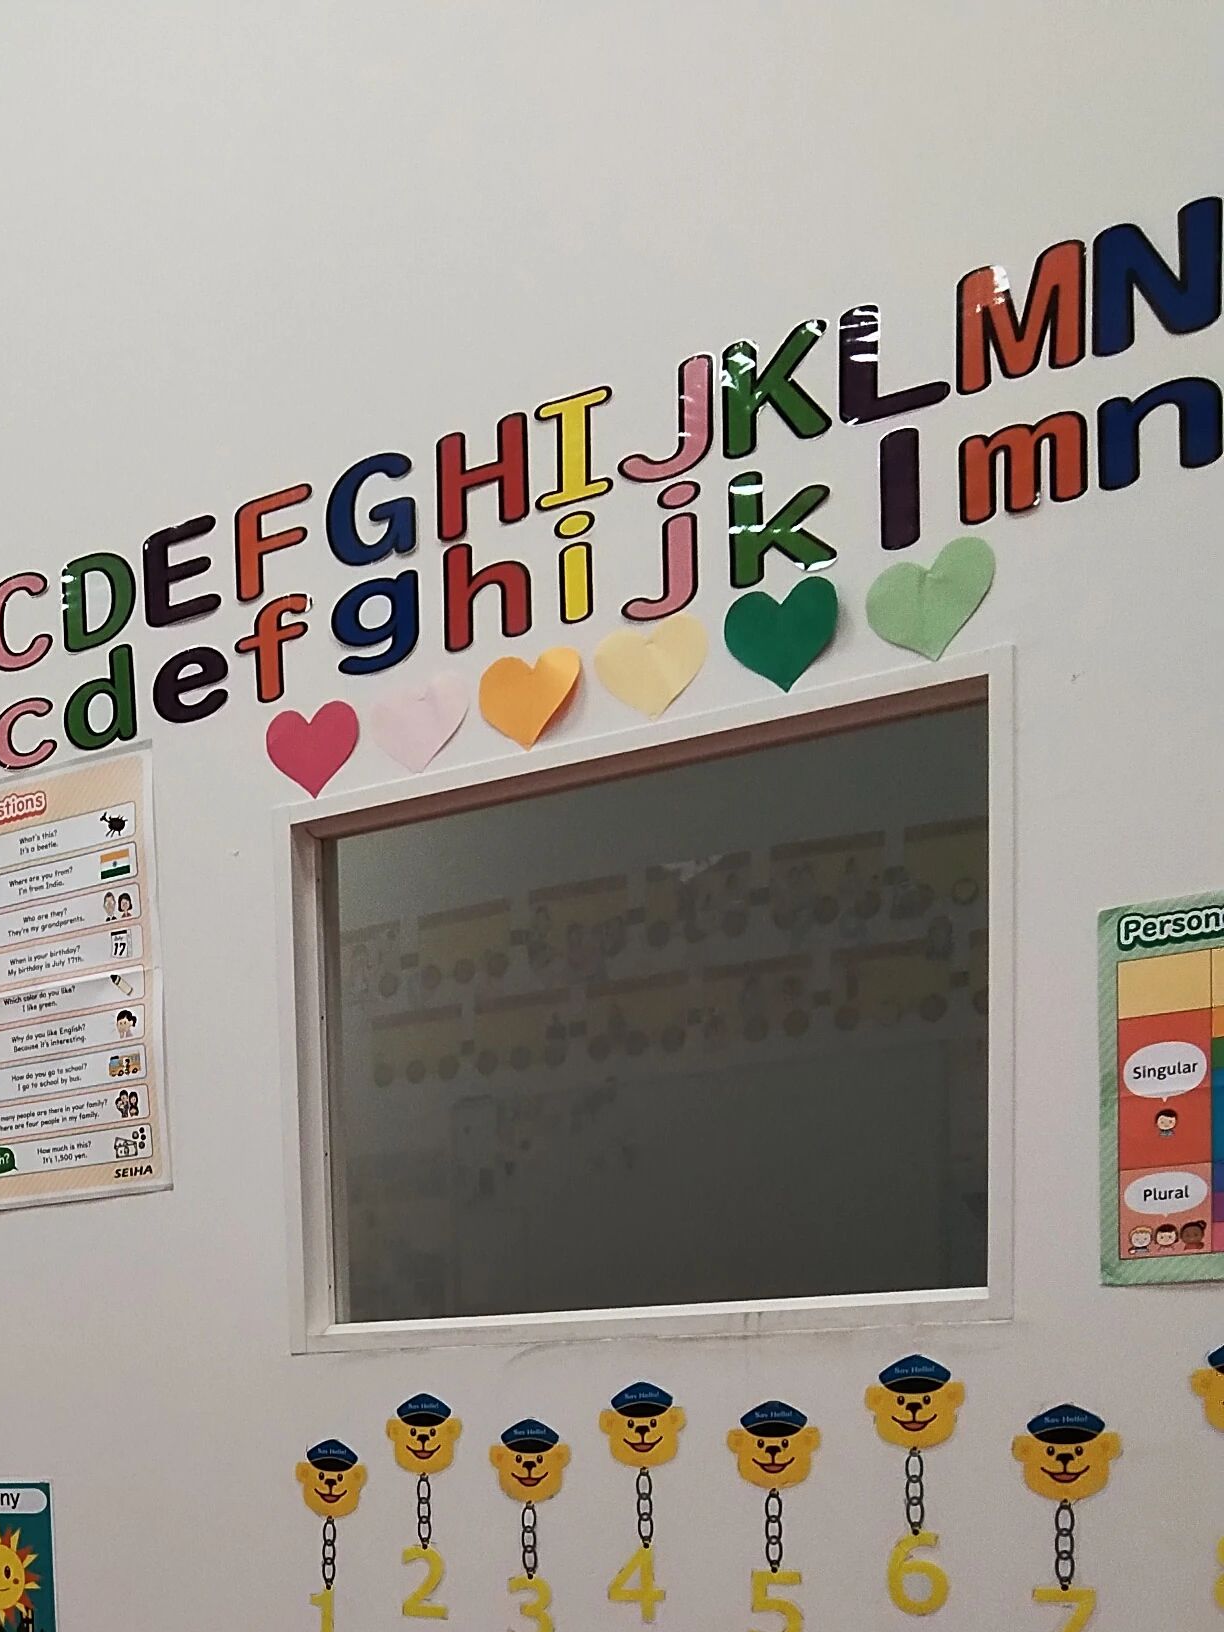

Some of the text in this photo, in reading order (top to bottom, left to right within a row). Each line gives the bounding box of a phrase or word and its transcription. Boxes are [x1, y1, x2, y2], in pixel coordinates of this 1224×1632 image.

[1123, 909, 1224, 942] Person
[113, 942, 126, 956] 17
[1132, 1058, 1199, 1081] Singular
[114, 1164, 153, 1179] SEIHA
[1142, 1184, 1190, 1203] Plural
[401, 1544, 449, 1621] 2
[607, 1543, 666, 1624] 4
[887, 1530, 951, 1618] 6
